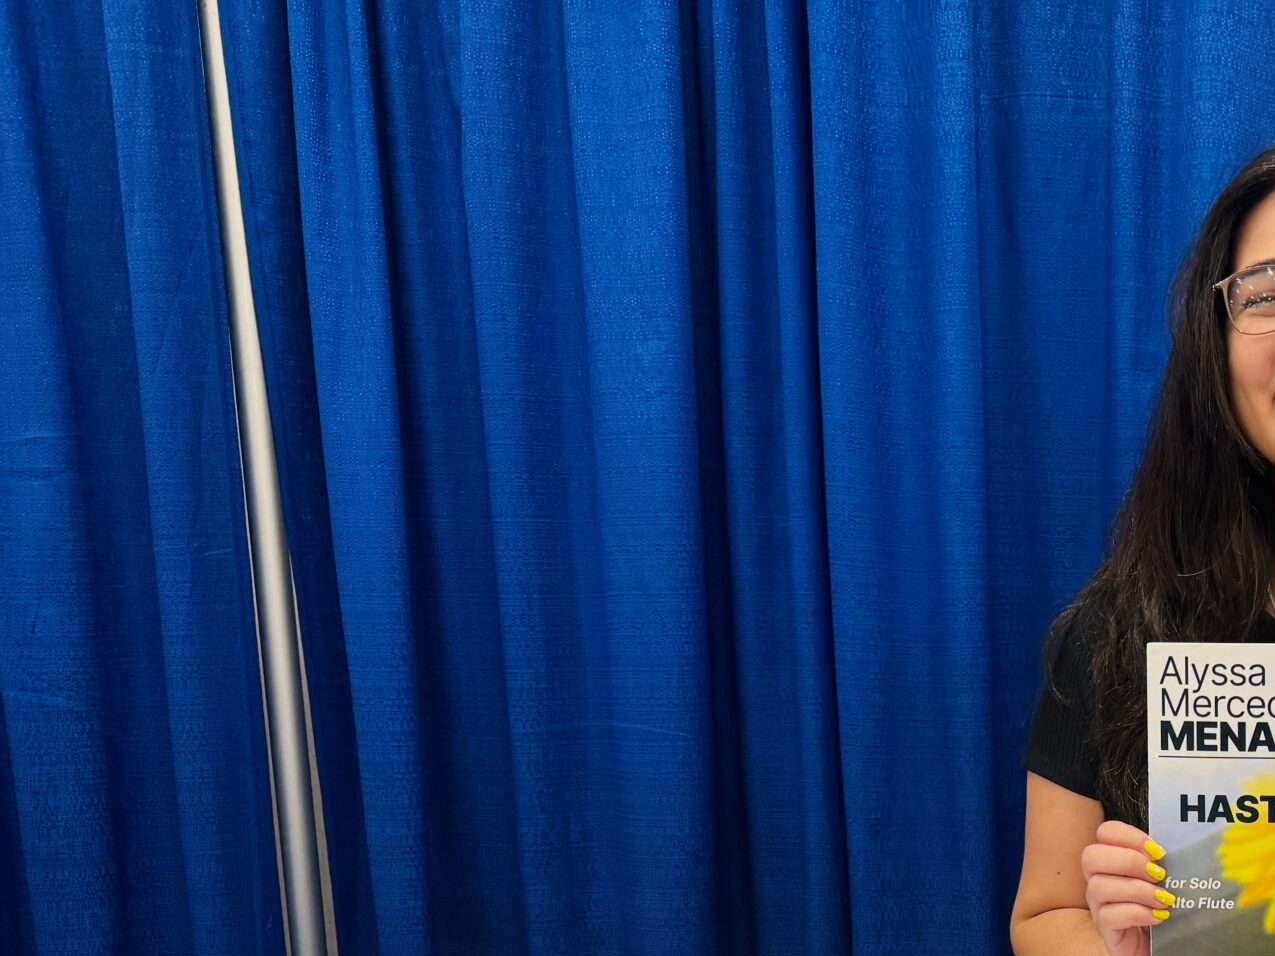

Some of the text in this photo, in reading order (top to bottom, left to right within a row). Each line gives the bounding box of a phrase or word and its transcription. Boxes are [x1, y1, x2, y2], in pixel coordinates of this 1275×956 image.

[1160, 656, 1266, 692] Alyssa
[1165, 876, 1222, 890] for Solo
[1198, 897, 1235, 910] Flute
